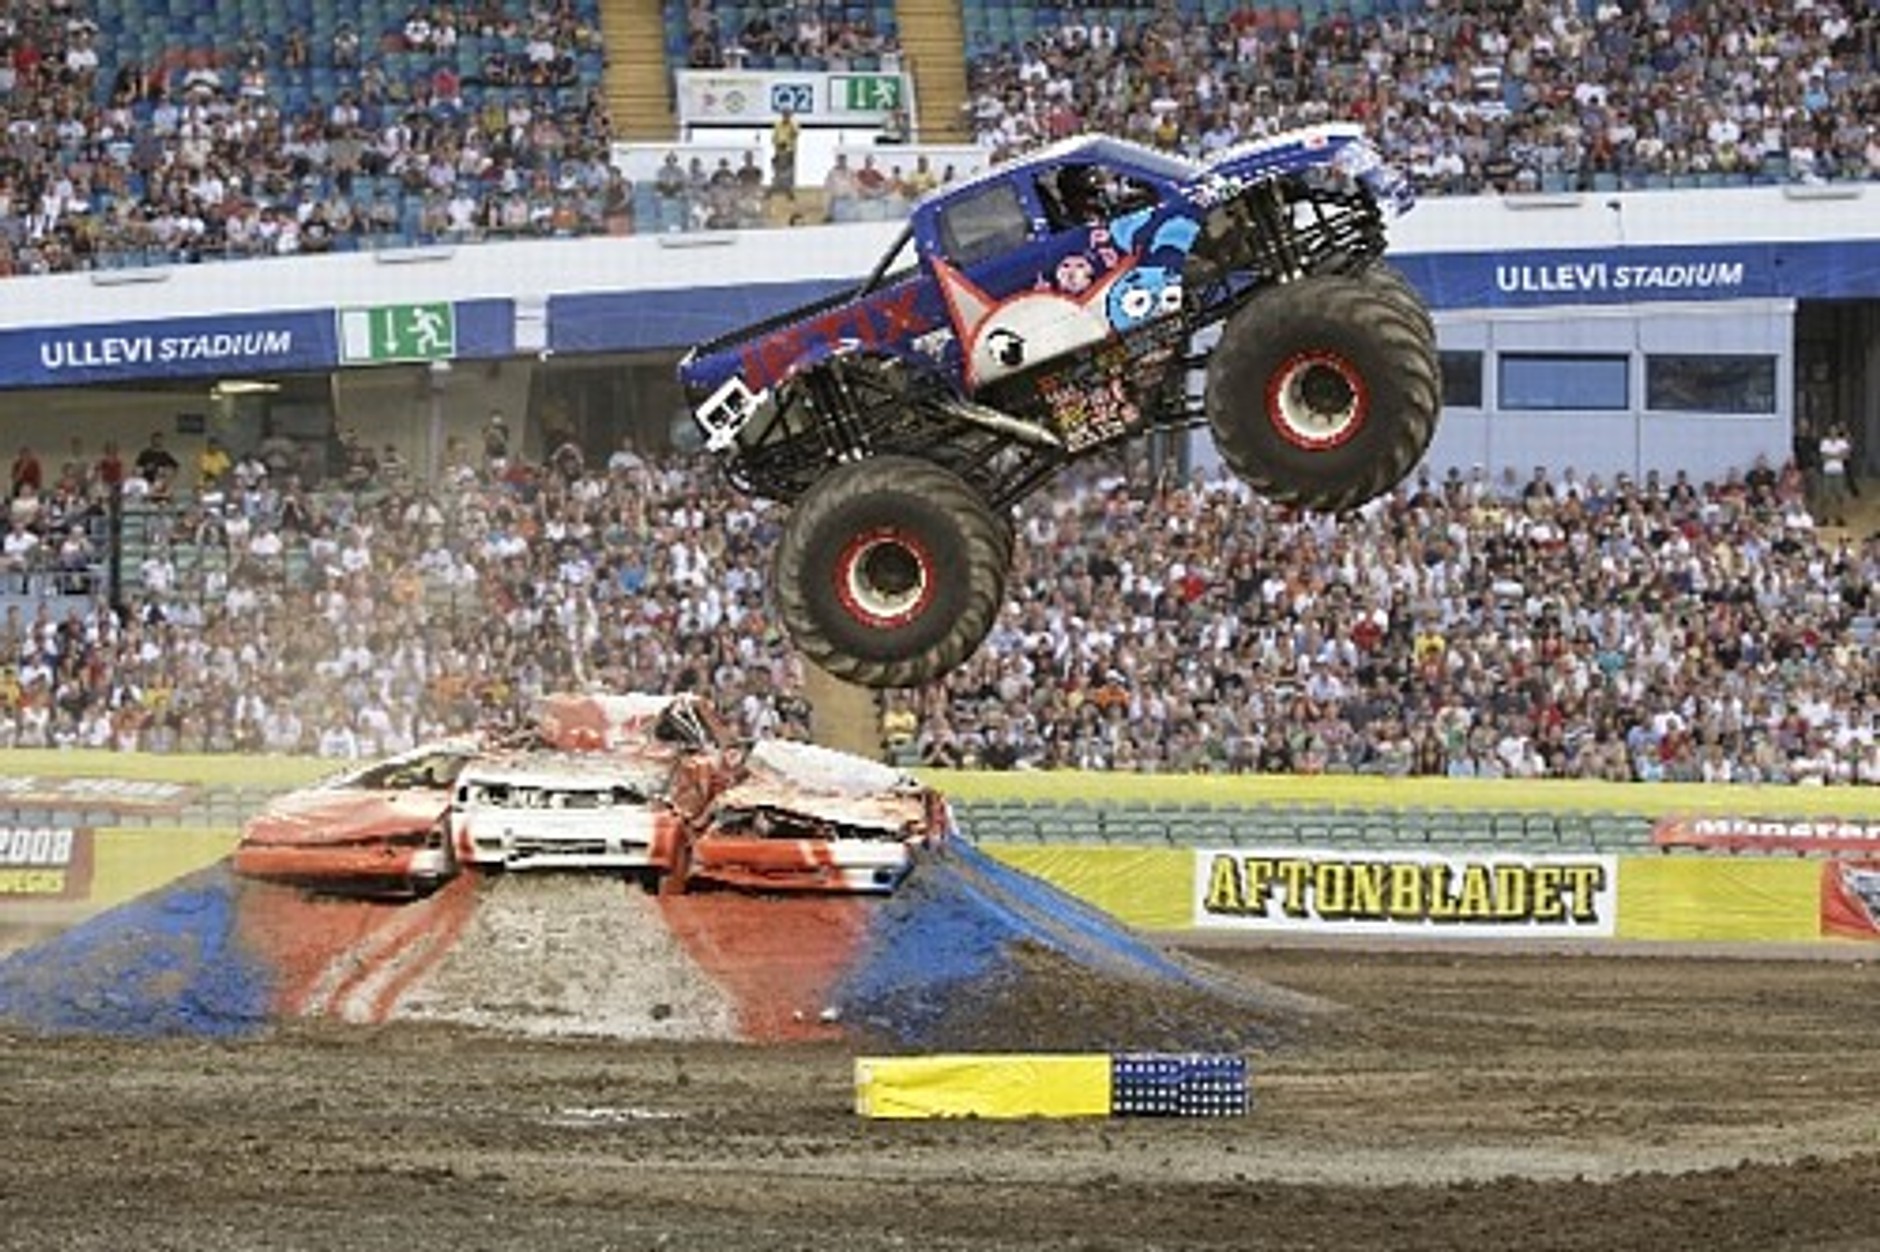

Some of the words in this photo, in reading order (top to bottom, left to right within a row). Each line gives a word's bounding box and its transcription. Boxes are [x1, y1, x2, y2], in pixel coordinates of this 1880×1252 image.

[1496, 262, 1607, 292] ULLEVI
[1613, 262, 1743, 288] STADIUM
[40, 336, 152, 369] ULLEVI
[158, 330, 292, 362] STADIUM
[1204, 853, 1606, 924] AFTONBLADET
